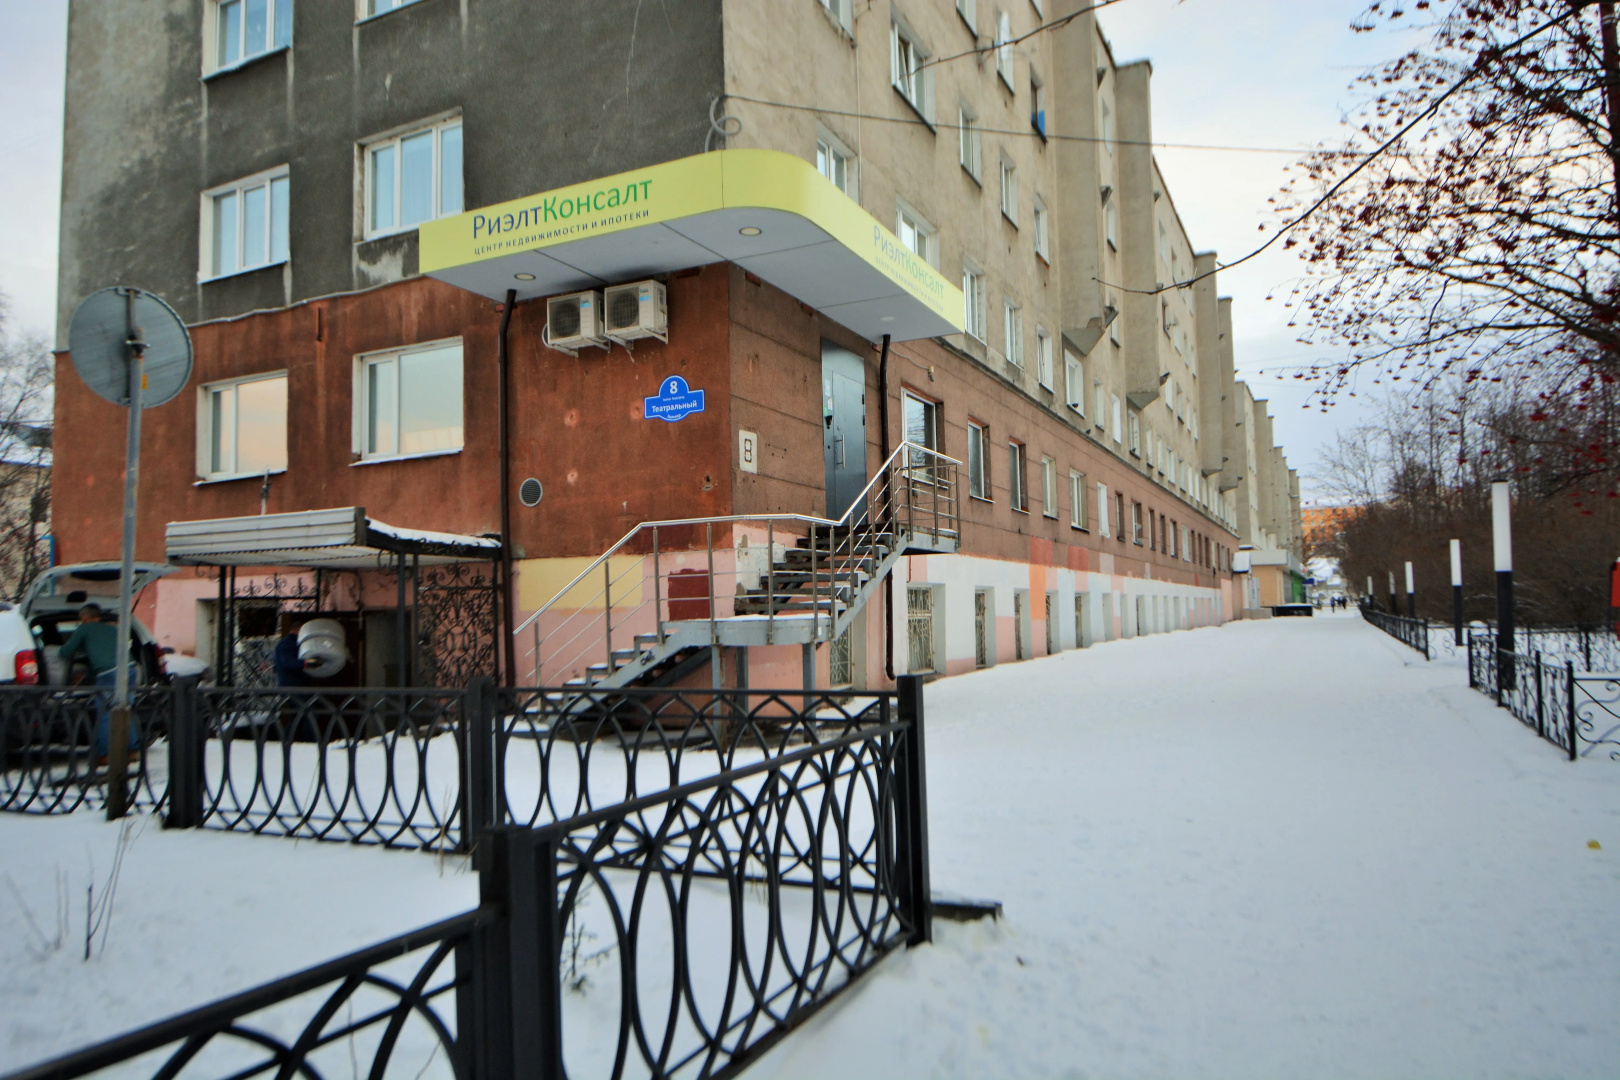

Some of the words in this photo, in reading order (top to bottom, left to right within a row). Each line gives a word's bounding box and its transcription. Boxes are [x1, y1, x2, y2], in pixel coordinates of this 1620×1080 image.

[473, 179, 652, 239] РиэлтКонсалт
[474, 242, 503, 255] ЦЕНТР
[505, 223, 588, 248] НЕДВИЖИМОСТИ
[591, 221, 598, 229] И
[601, 209, 649, 227] ИПОТЕКИ
[873, 224, 944, 299] РиэлтКонсалт
[651, 399, 698, 413] Театральный
[669, 380, 678, 394] 8
